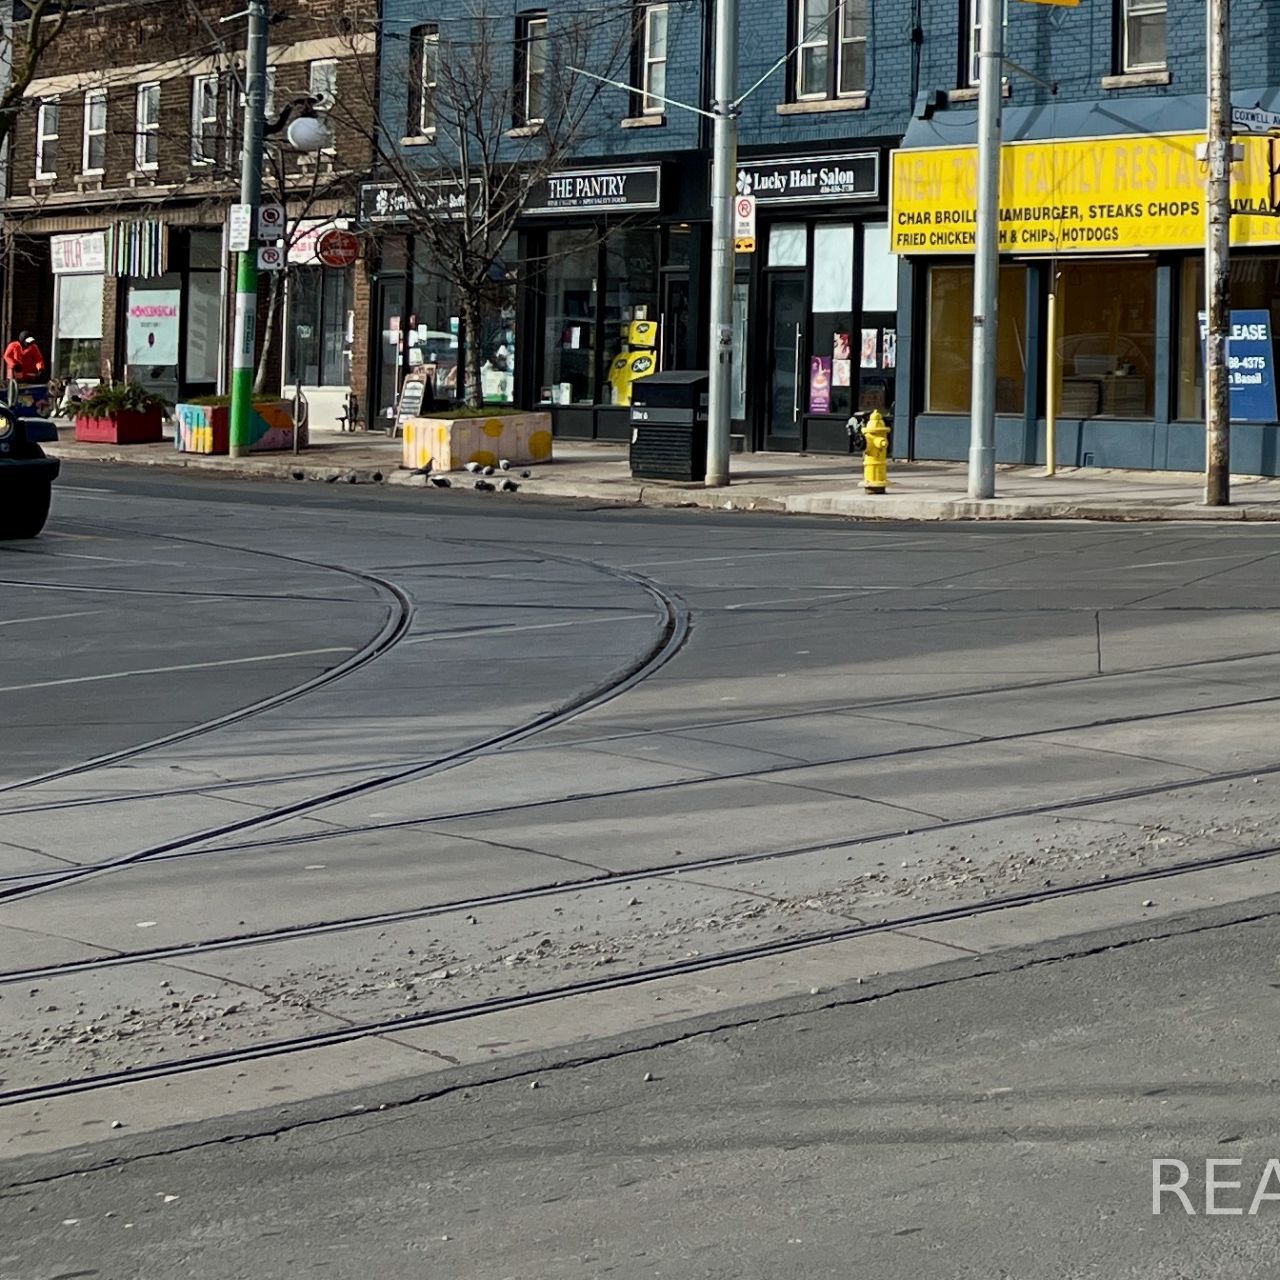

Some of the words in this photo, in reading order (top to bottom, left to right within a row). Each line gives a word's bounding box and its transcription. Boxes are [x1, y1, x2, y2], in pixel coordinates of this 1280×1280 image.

[1234, 109, 1270, 125] COXWELL
[548, 179, 574, 199] THE
[576, 175, 627, 198] PANTRY
[753, 171, 788, 193] Lucky
[790, 169, 818, 188] Hair
[819, 167, 855, 186] Salon
[952, 151, 1014, 200] TON
[898, 211, 931, 225] CHAR
[1088, 203, 1143, 219] STEAKS
[1149, 201, 1200, 217] CHOPS
[897, 231, 926, 246] FRIED
[1010, 229, 1017, 243] &
[1062, 226, 1119, 242] HOTDOGS
[1234, 372, 1262, 384] Bassil
